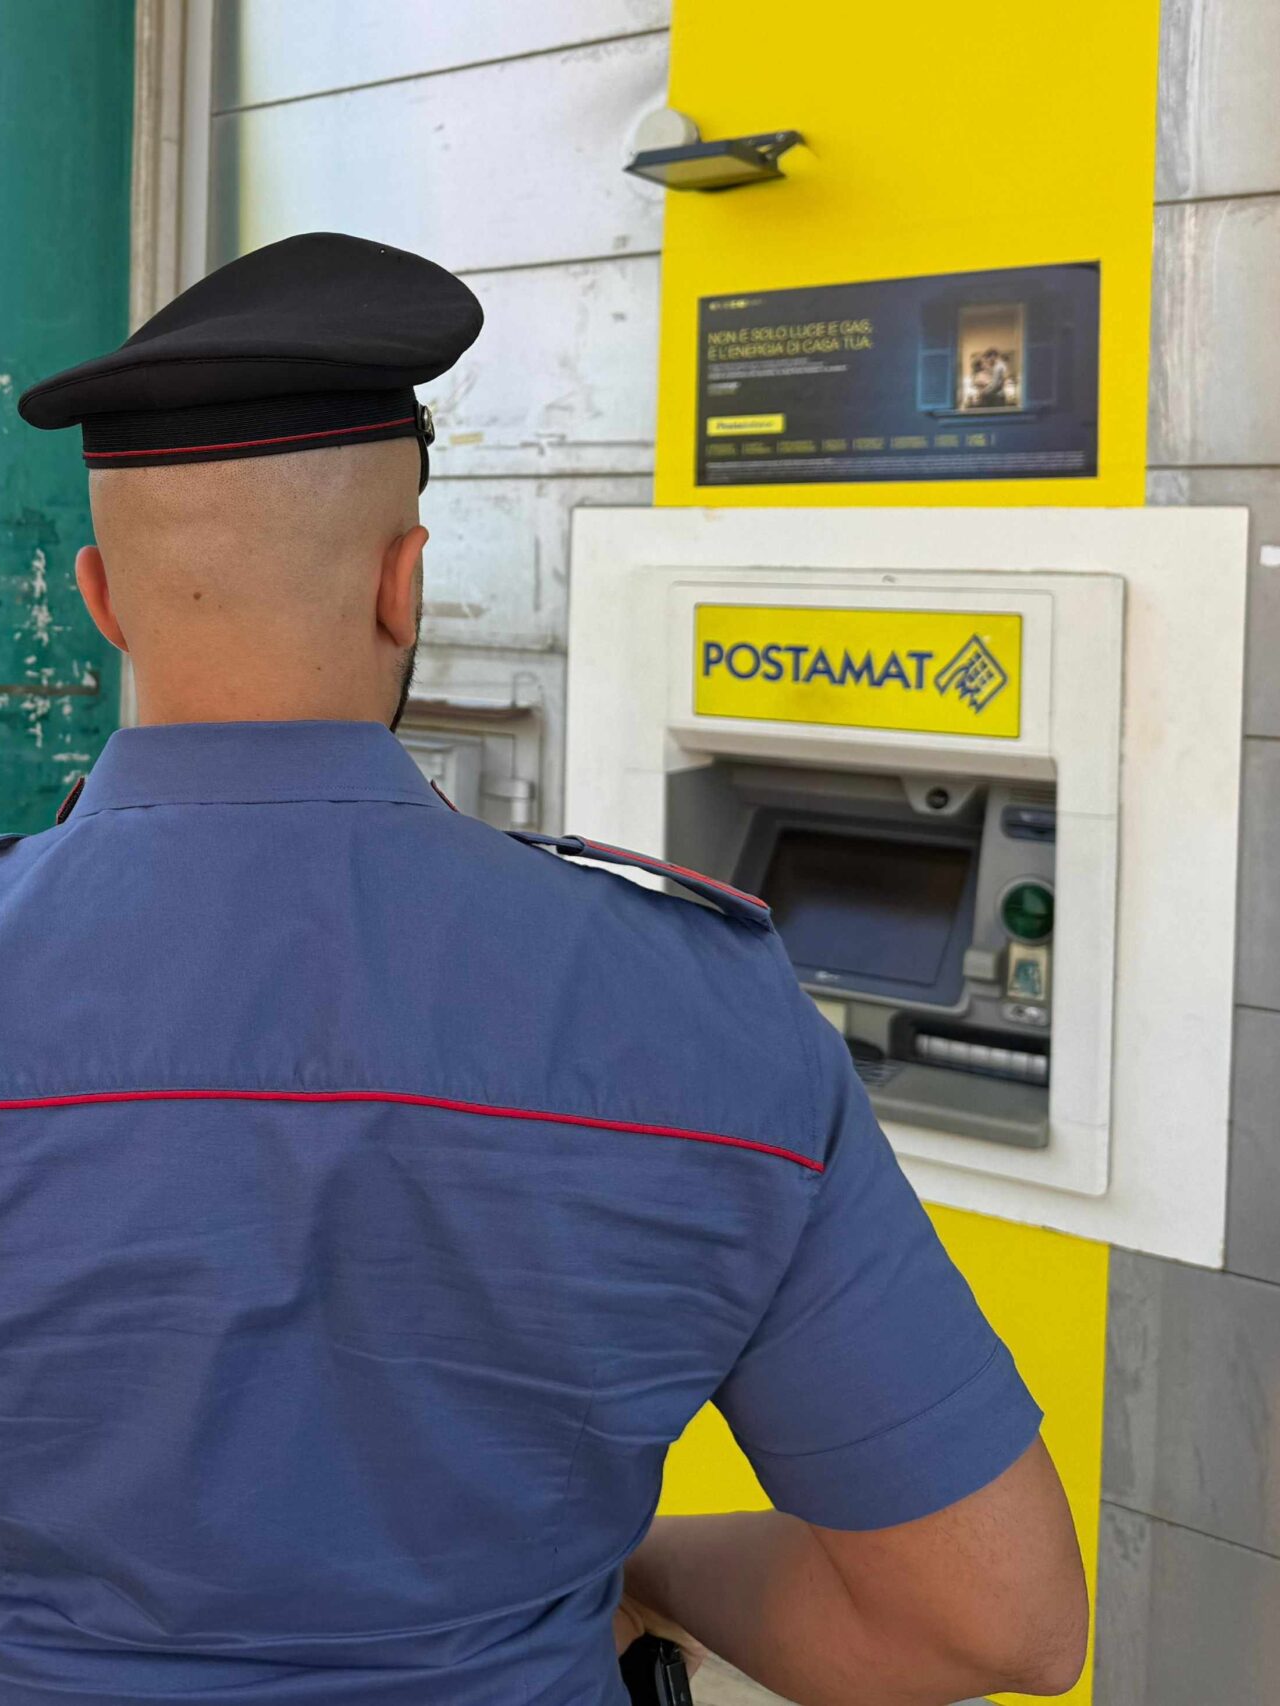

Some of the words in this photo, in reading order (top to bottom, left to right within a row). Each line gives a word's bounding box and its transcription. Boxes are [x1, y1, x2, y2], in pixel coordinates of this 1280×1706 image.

[708, 331, 737, 345] NON
[751, 326, 786, 342] SOLO
[789, 322, 826, 339] LUCE
[828, 321, 840, 336] E
[786, 340, 800, 355] DI
[802, 337, 840, 354] CASA
[702, 641, 933, 690] POSTAMAT
